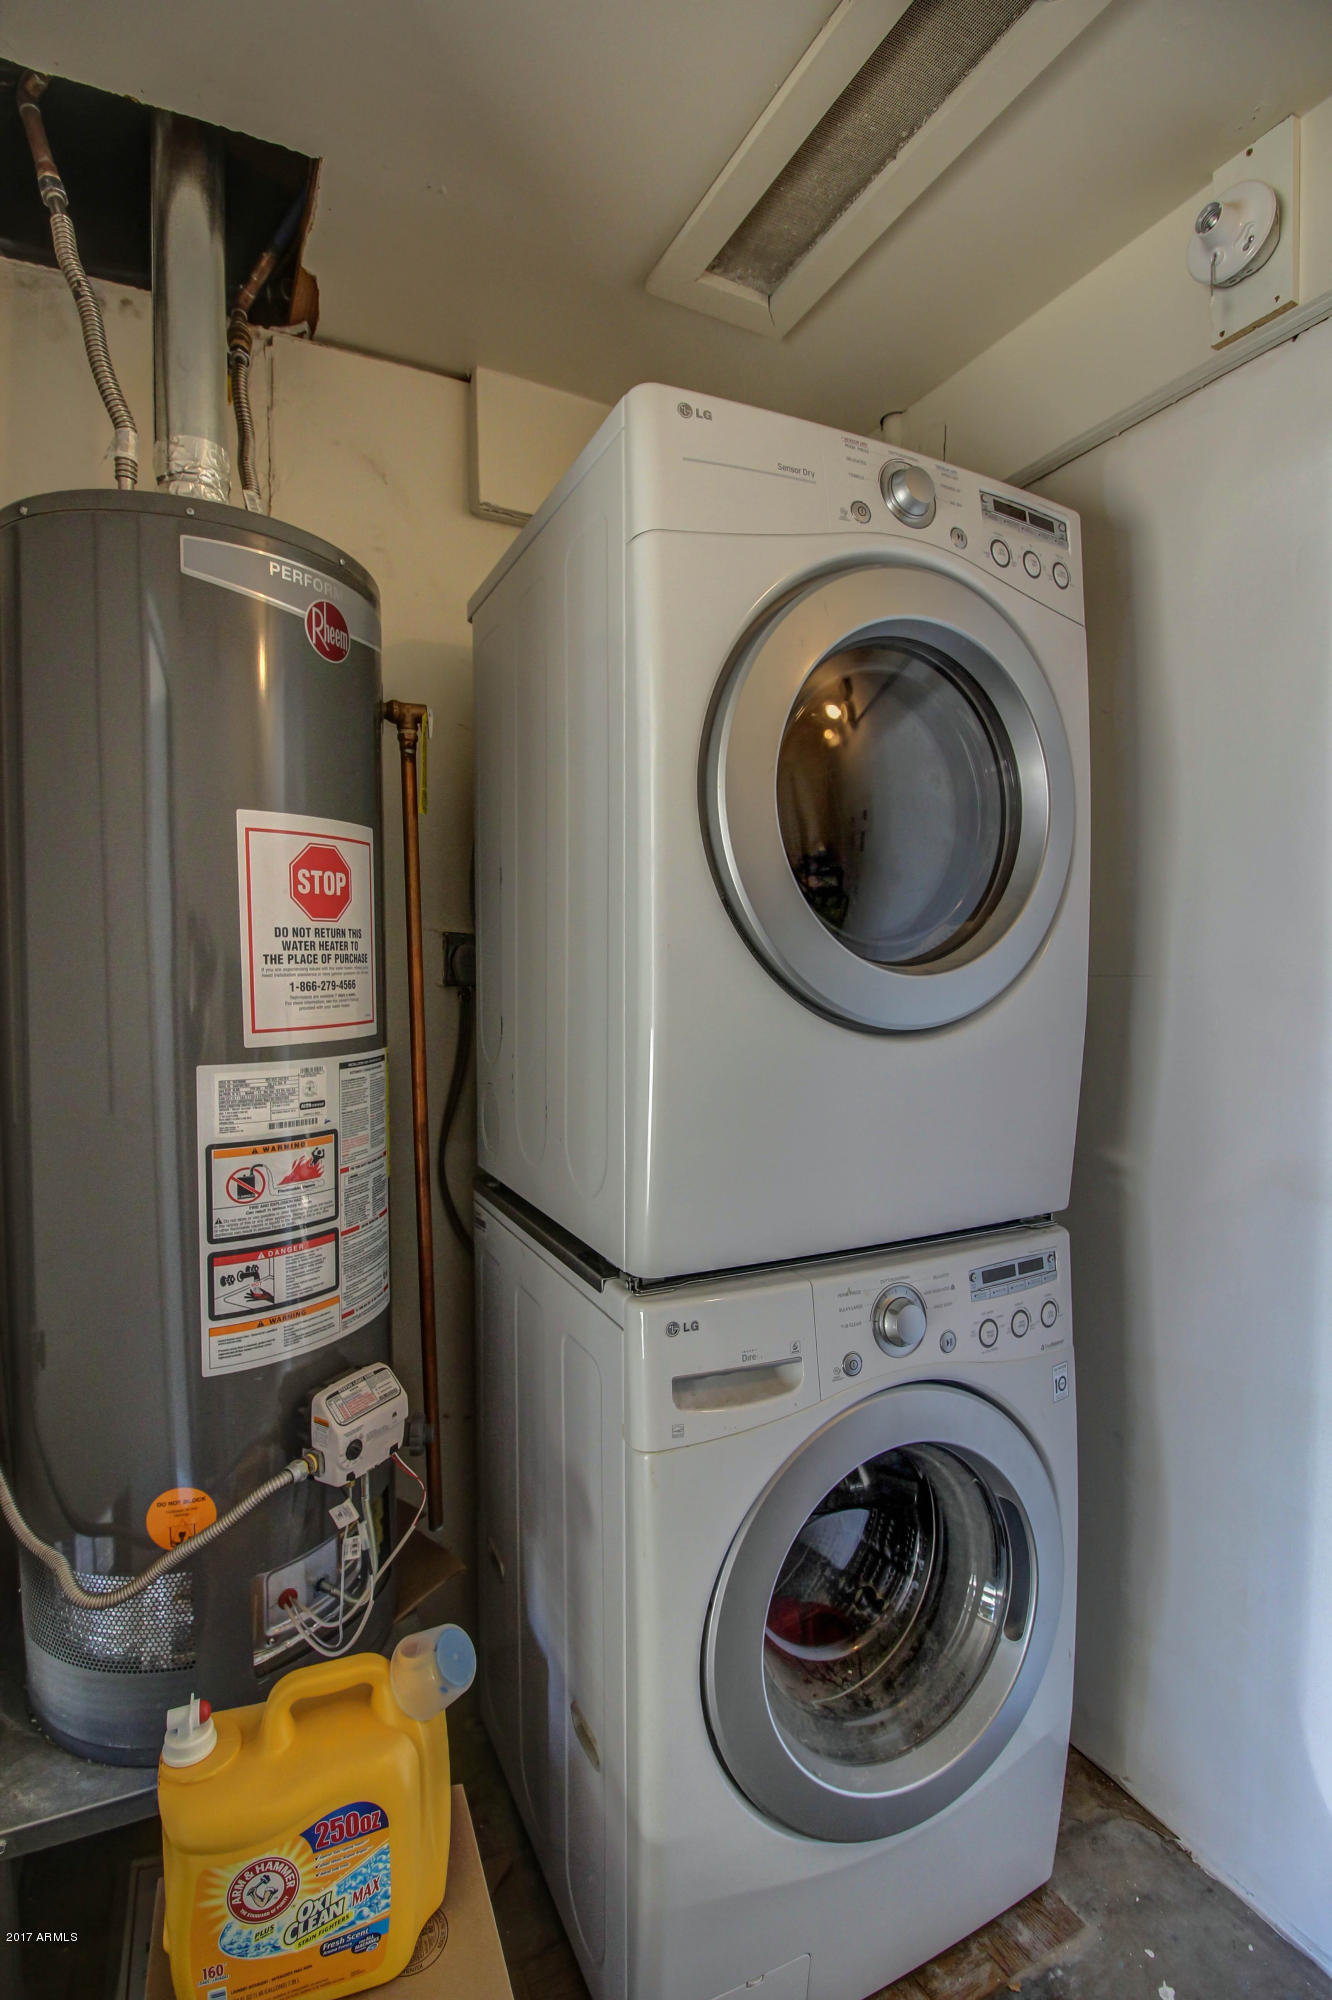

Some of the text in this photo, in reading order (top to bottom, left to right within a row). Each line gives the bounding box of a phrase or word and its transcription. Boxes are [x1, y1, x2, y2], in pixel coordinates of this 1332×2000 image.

[695, 408, 713, 421] LG
[777, 462, 816, 479] Sensor Dry
[312, 600, 349, 653] Rheem
[297, 869, 347, 896] STOP
[274, 927, 362, 939] DO NOT RETURN THIS
[281, 940, 359, 952] WATER HEATER TO
[263, 953, 368, 965] THE PLACE OF PURCHASE
[289, 979, 356, 992] 1-866-279-4566
[262, 1141, 307, 1153] WARNING
[267, 1242, 309, 1258] DANGER
[268, 1310, 307, 1326] WARNING
[683, 1320, 700, 1333] LG
[314, 1810, 382, 1850] 250oz
[232, 1861, 296, 1905] ARM & HAMMER
[352, 1875, 380, 1907] MAX
[297, 1890, 333, 1923] OXI
[283, 1896, 346, 1946] CLEAN
[254, 1923, 275, 1940] PLUS
[297, 1913, 350, 1948] STAIN FIGHTERS
[322, 1938, 345, 1951] Fresh
[346, 1928, 369, 1943] Scent
[202, 1964, 224, 1981] 160
